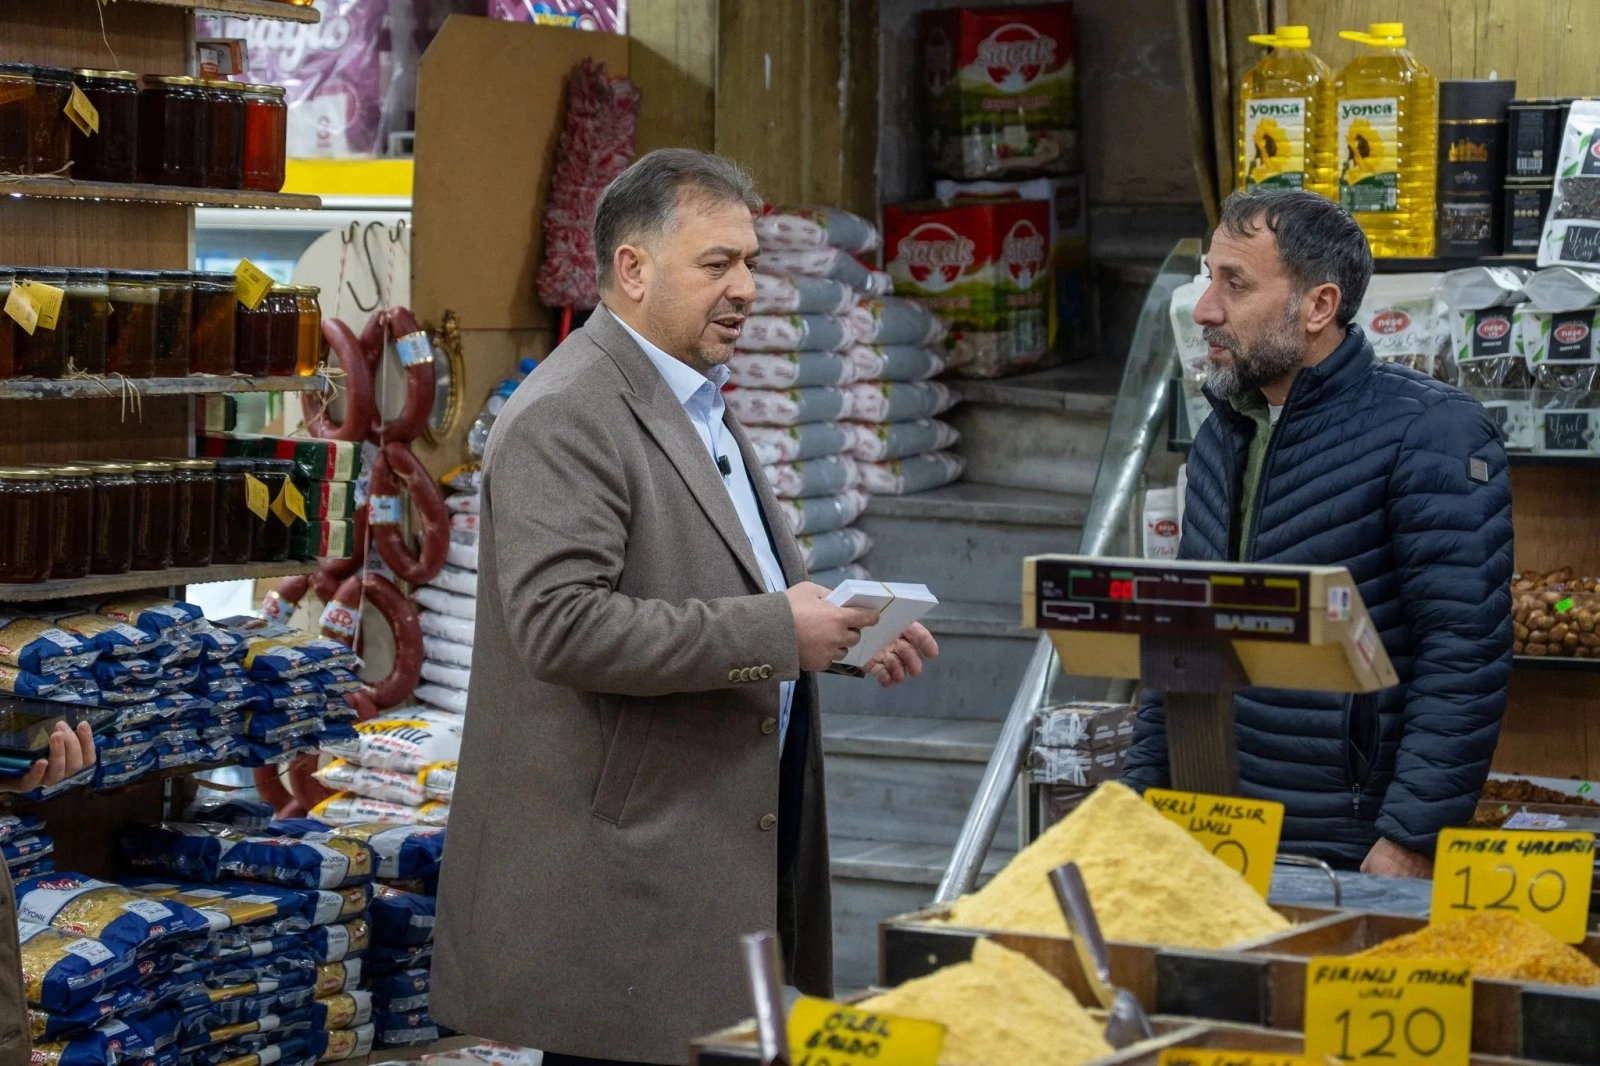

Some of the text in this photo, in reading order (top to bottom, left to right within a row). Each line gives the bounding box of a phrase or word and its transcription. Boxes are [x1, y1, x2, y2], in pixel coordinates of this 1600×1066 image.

[1250, 103, 1300, 119] yonca
[1342, 103, 1392, 119] yonca
[1209, 802, 1267, 824] MISIR
[1450, 866, 1566, 913] 120
[1330, 1007, 1446, 1061] 120
